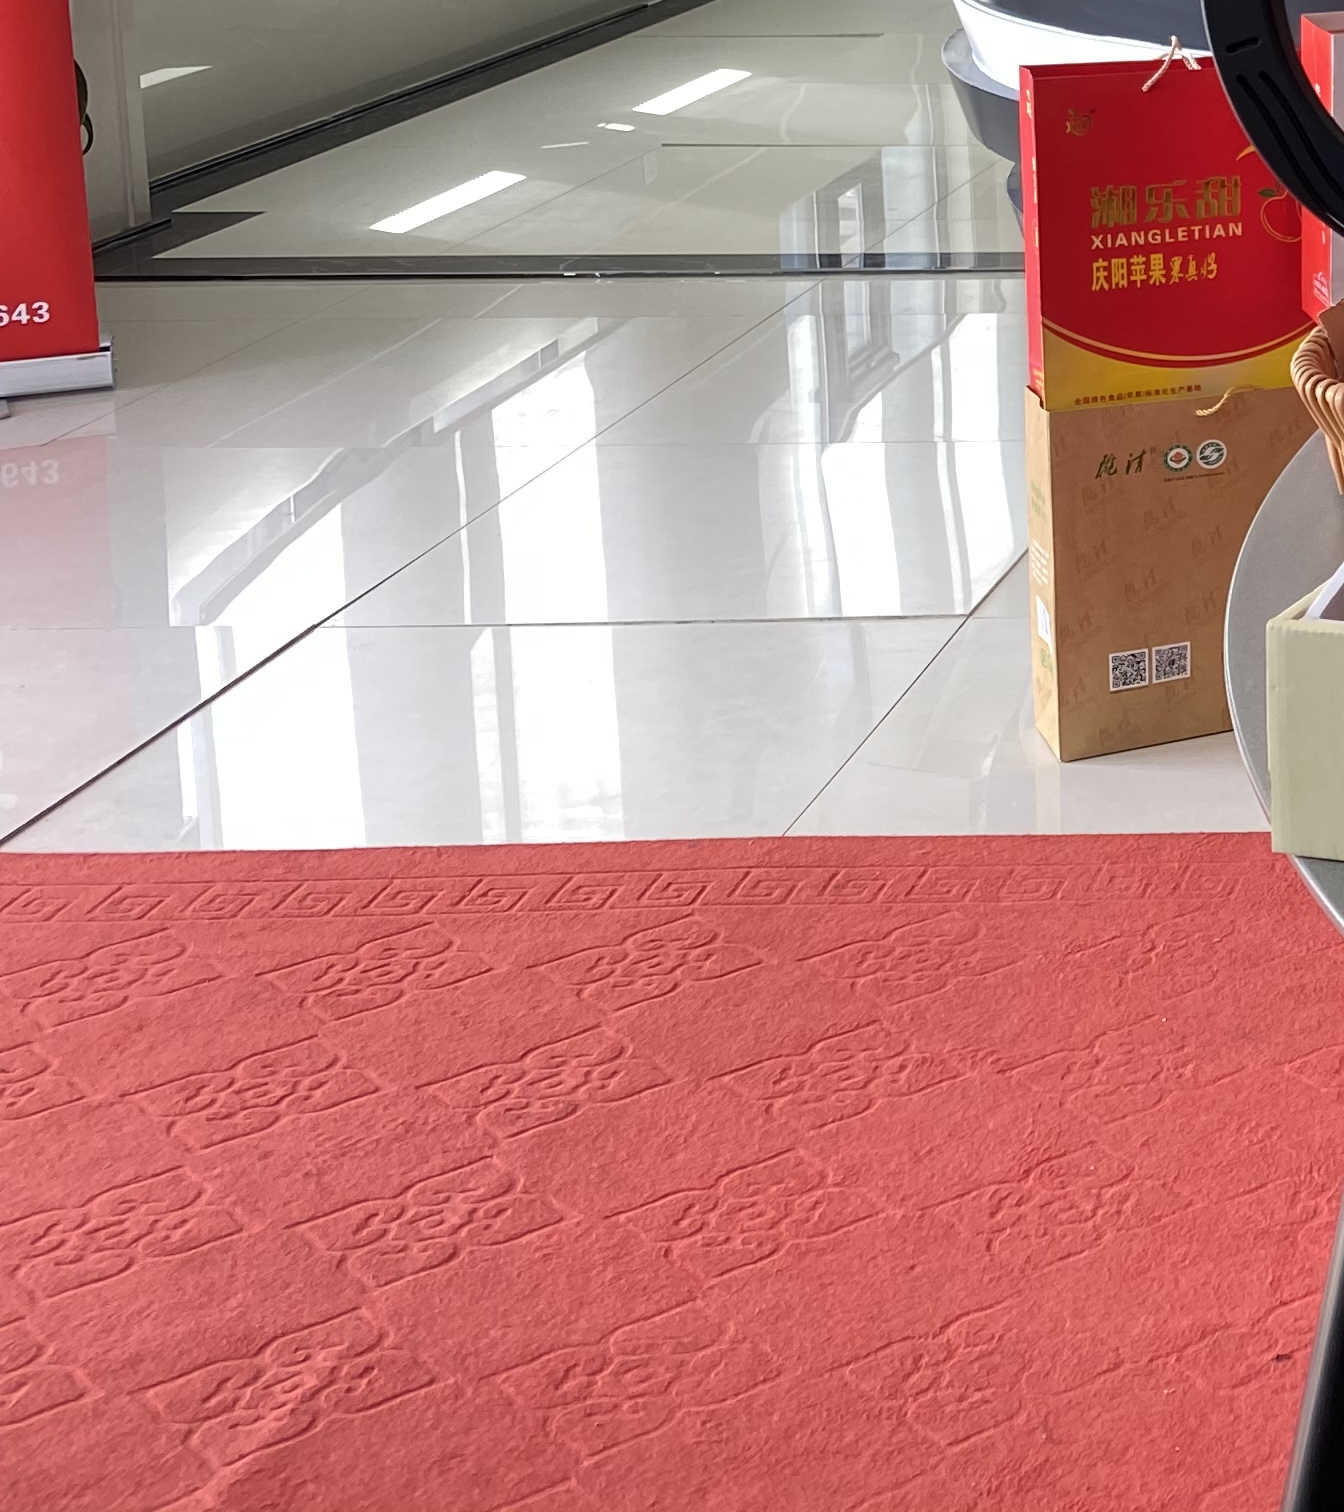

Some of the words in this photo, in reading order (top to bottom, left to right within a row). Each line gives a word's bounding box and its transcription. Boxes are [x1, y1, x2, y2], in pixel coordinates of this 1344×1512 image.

[1091, 222, 1243, 250] XIANGLETIAN
[1091, 253, 1166, 292] 庆阳苹果
